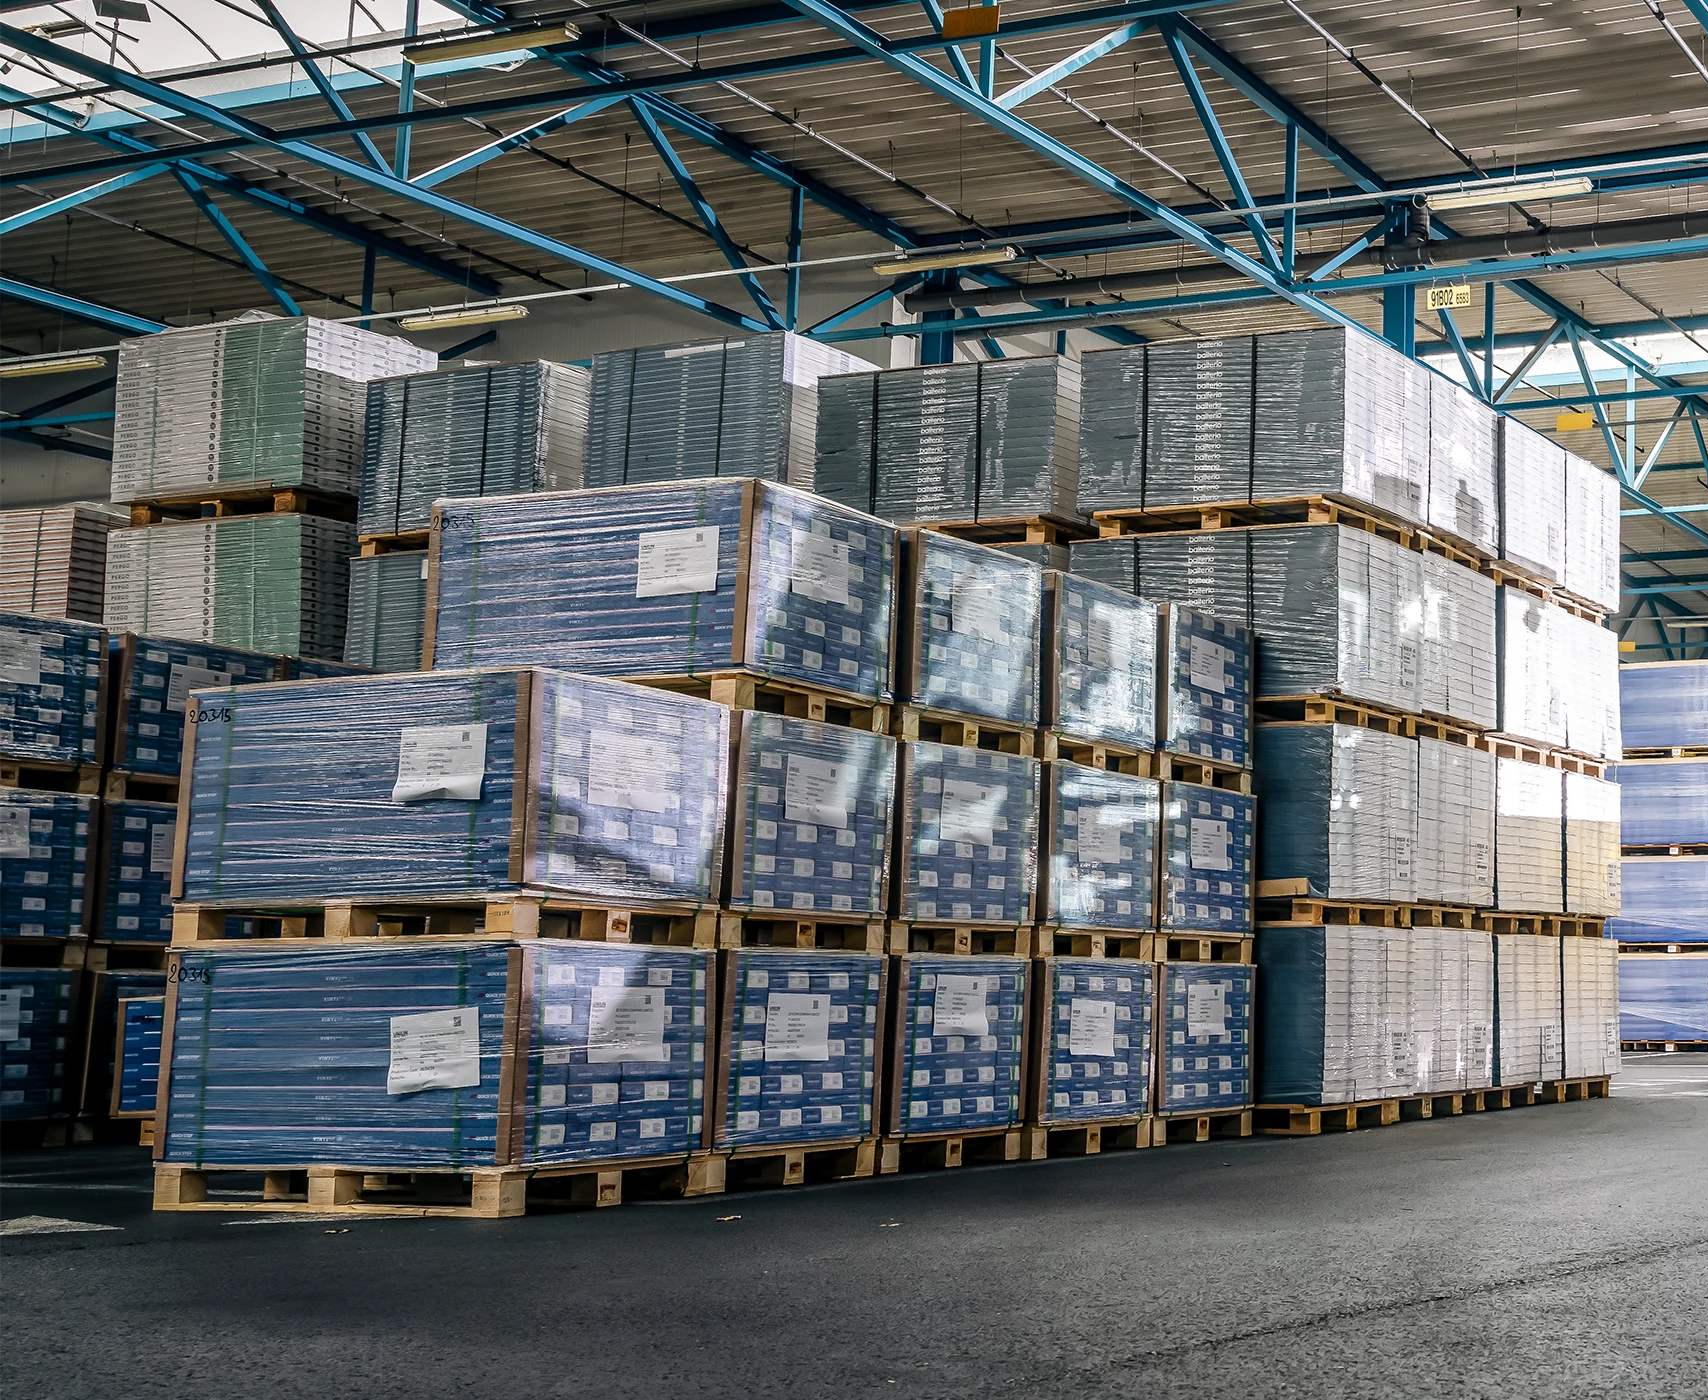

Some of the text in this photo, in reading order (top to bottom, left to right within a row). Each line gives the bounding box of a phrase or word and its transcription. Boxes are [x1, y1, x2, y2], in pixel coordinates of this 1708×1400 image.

[1431, 289, 1454, 307] 91B02
[1197, 351, 1222, 359] balterio
[1197, 361, 1222, 369] balterio
[1197, 371, 1222, 379] balterio
[1197, 381, 1222, 389] balterio
[1196, 412, 1222, 420] balterio
[1196, 422, 1222, 430] balterio
[919, 446, 943, 454] balterio
[1195, 443, 1221, 451] balterio
[919, 456, 942, 464] balterio
[1195, 453, 1220, 461] balterio
[919, 466, 942, 474] balterio
[1189, 545, 1214, 553] balterio
[1188, 556, 1214, 564] balterio
[190, 707, 232, 723] 20315
[168, 964, 210, 984] 20315
